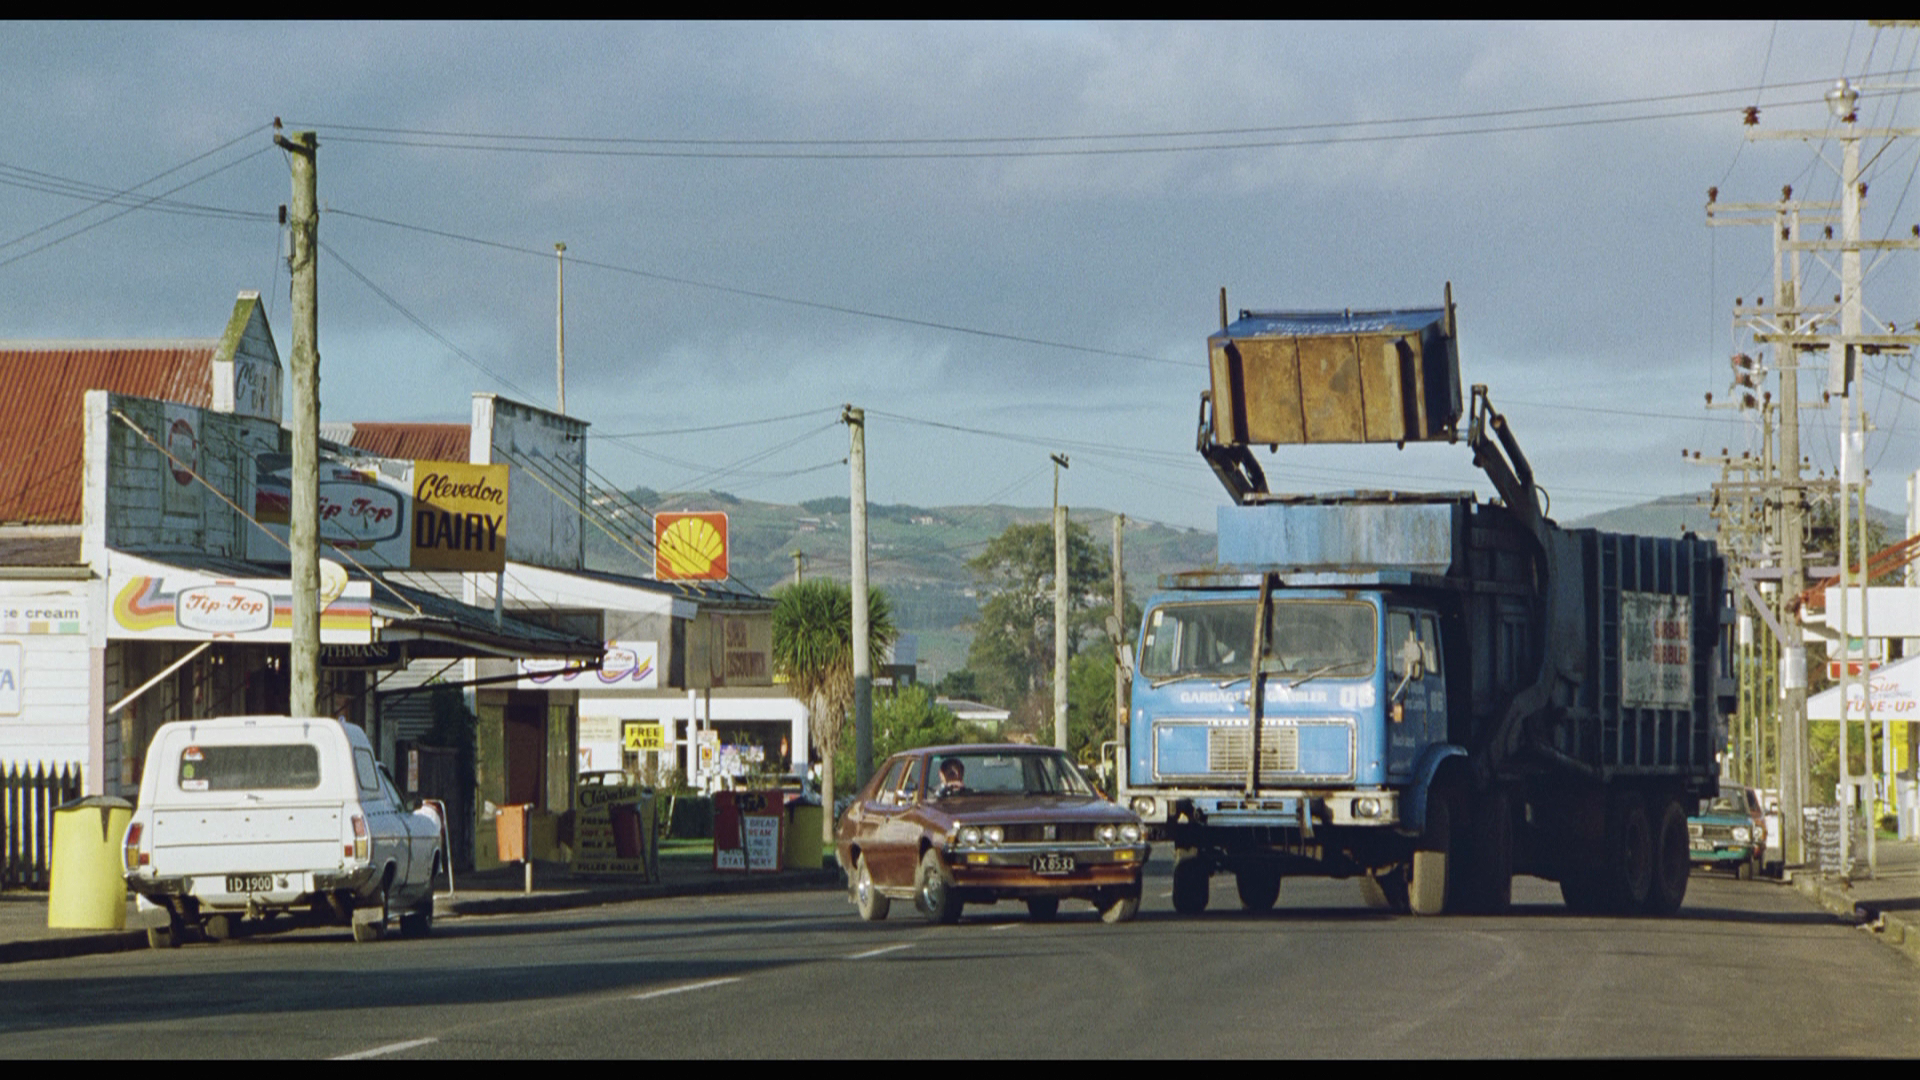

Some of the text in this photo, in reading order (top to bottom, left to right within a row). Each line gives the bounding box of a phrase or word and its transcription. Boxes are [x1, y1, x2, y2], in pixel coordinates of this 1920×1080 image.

[417, 473, 504, 505] Clevedon
[320, 497, 392, 523] ip Top
[415, 510, 503, 551] DAIRY
[25, 609, 79, 619] cream
[320, 644, 388, 658] THMANS
[630, 727, 660, 737] FREE
[632, 738, 659, 748] AIR
[722, 858, 772, 867] STATNERY
[246, 876, 272, 891] 1900
